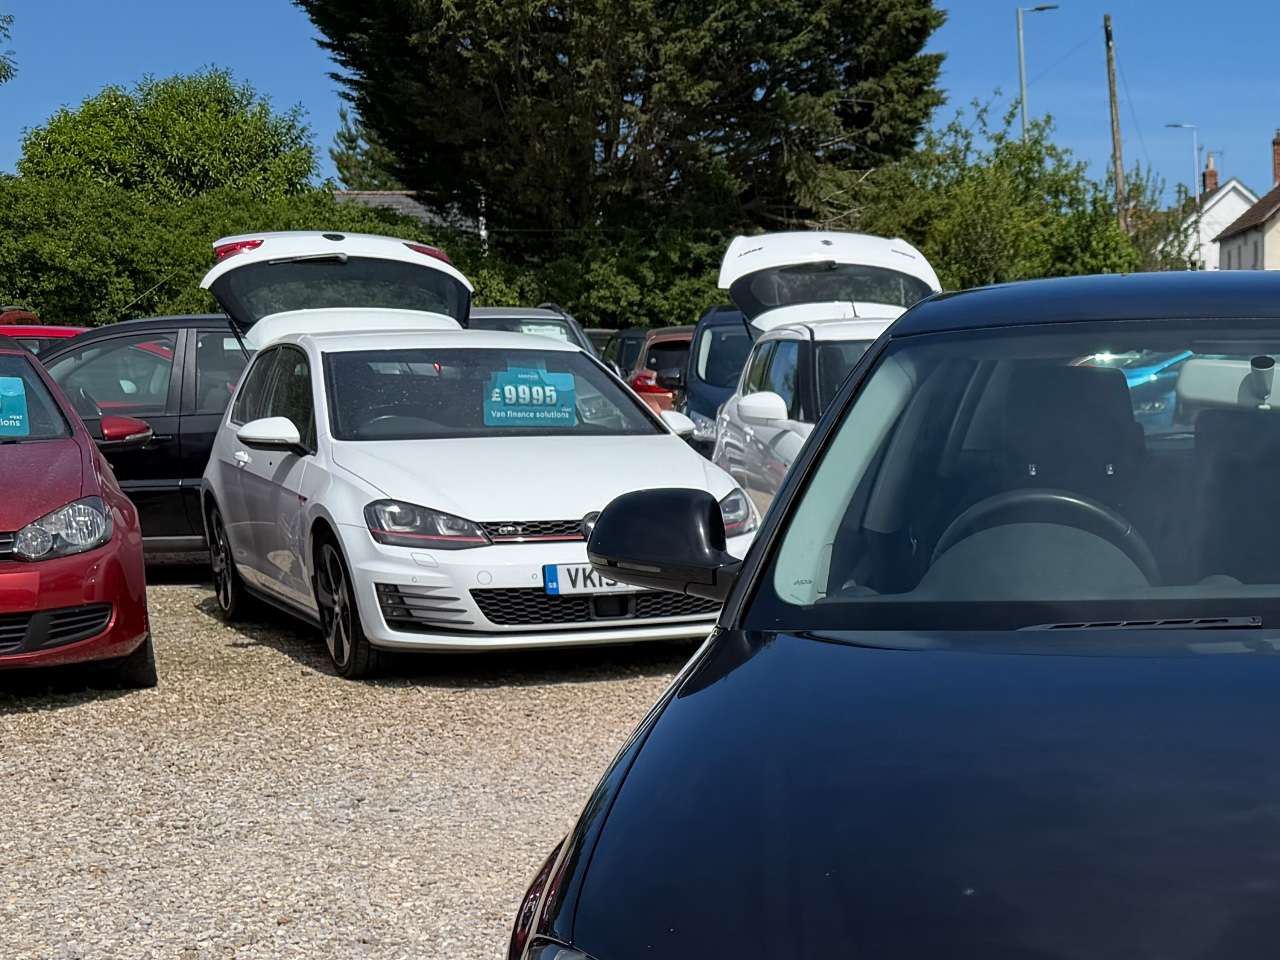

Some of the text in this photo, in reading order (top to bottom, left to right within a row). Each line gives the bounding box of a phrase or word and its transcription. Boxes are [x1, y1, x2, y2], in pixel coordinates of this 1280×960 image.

[491, 385, 557, 405] £9995
[491, 409, 569, 418] Van finance solutions
